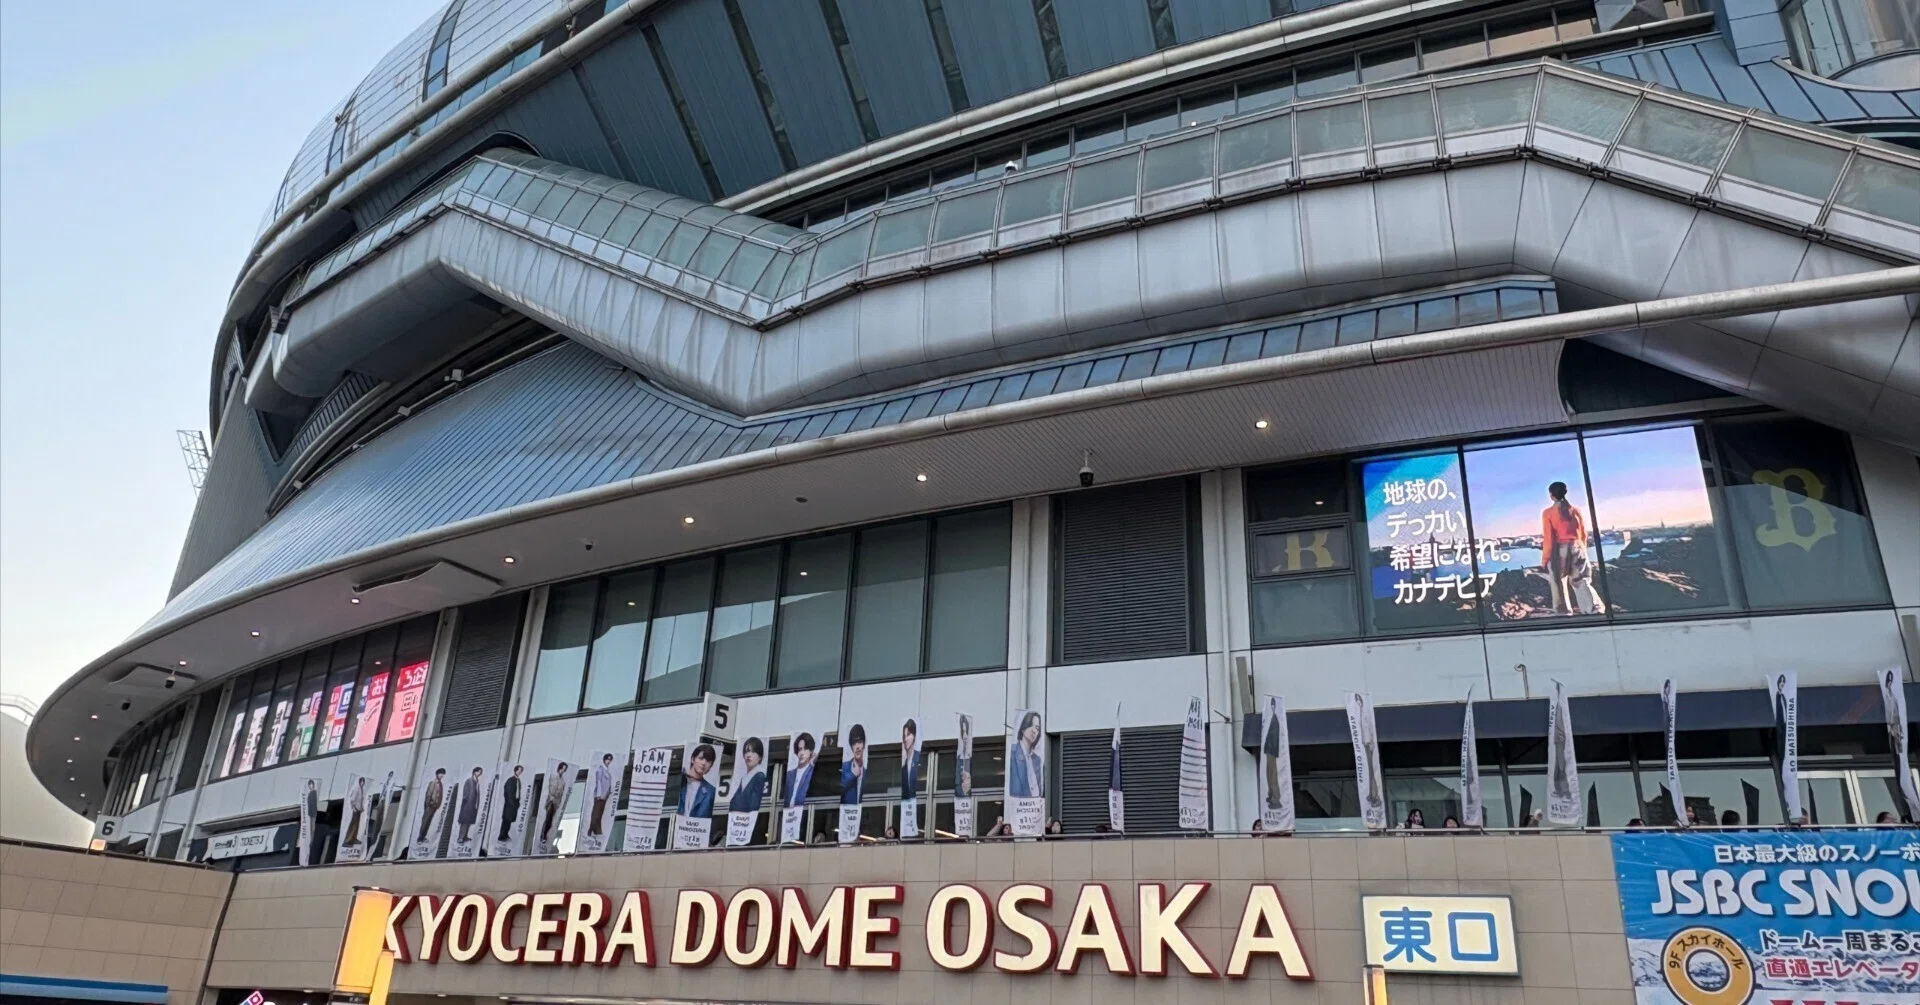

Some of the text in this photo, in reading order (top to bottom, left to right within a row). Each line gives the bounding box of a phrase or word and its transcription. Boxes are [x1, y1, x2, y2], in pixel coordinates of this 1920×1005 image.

[1383, 478, 1457, 506] 地球の、
[1751, 468, 1837, 552] B
[1389, 538, 1512, 572] 希望になれ。
[714, 703, 730, 730] 5
[717, 774, 732, 798] 5
[101, 821, 115, 836] 6
[1713, 842, 1920, 864] 日本最大級のスノーボ
[1651, 868, 1774, 916] JSBC
[384, 882, 1315, 980] KYOCERA DOME OSAKA
[1379, 906, 1499, 963] 東口
[1668, 934, 1745, 970] 9F スカイホール
